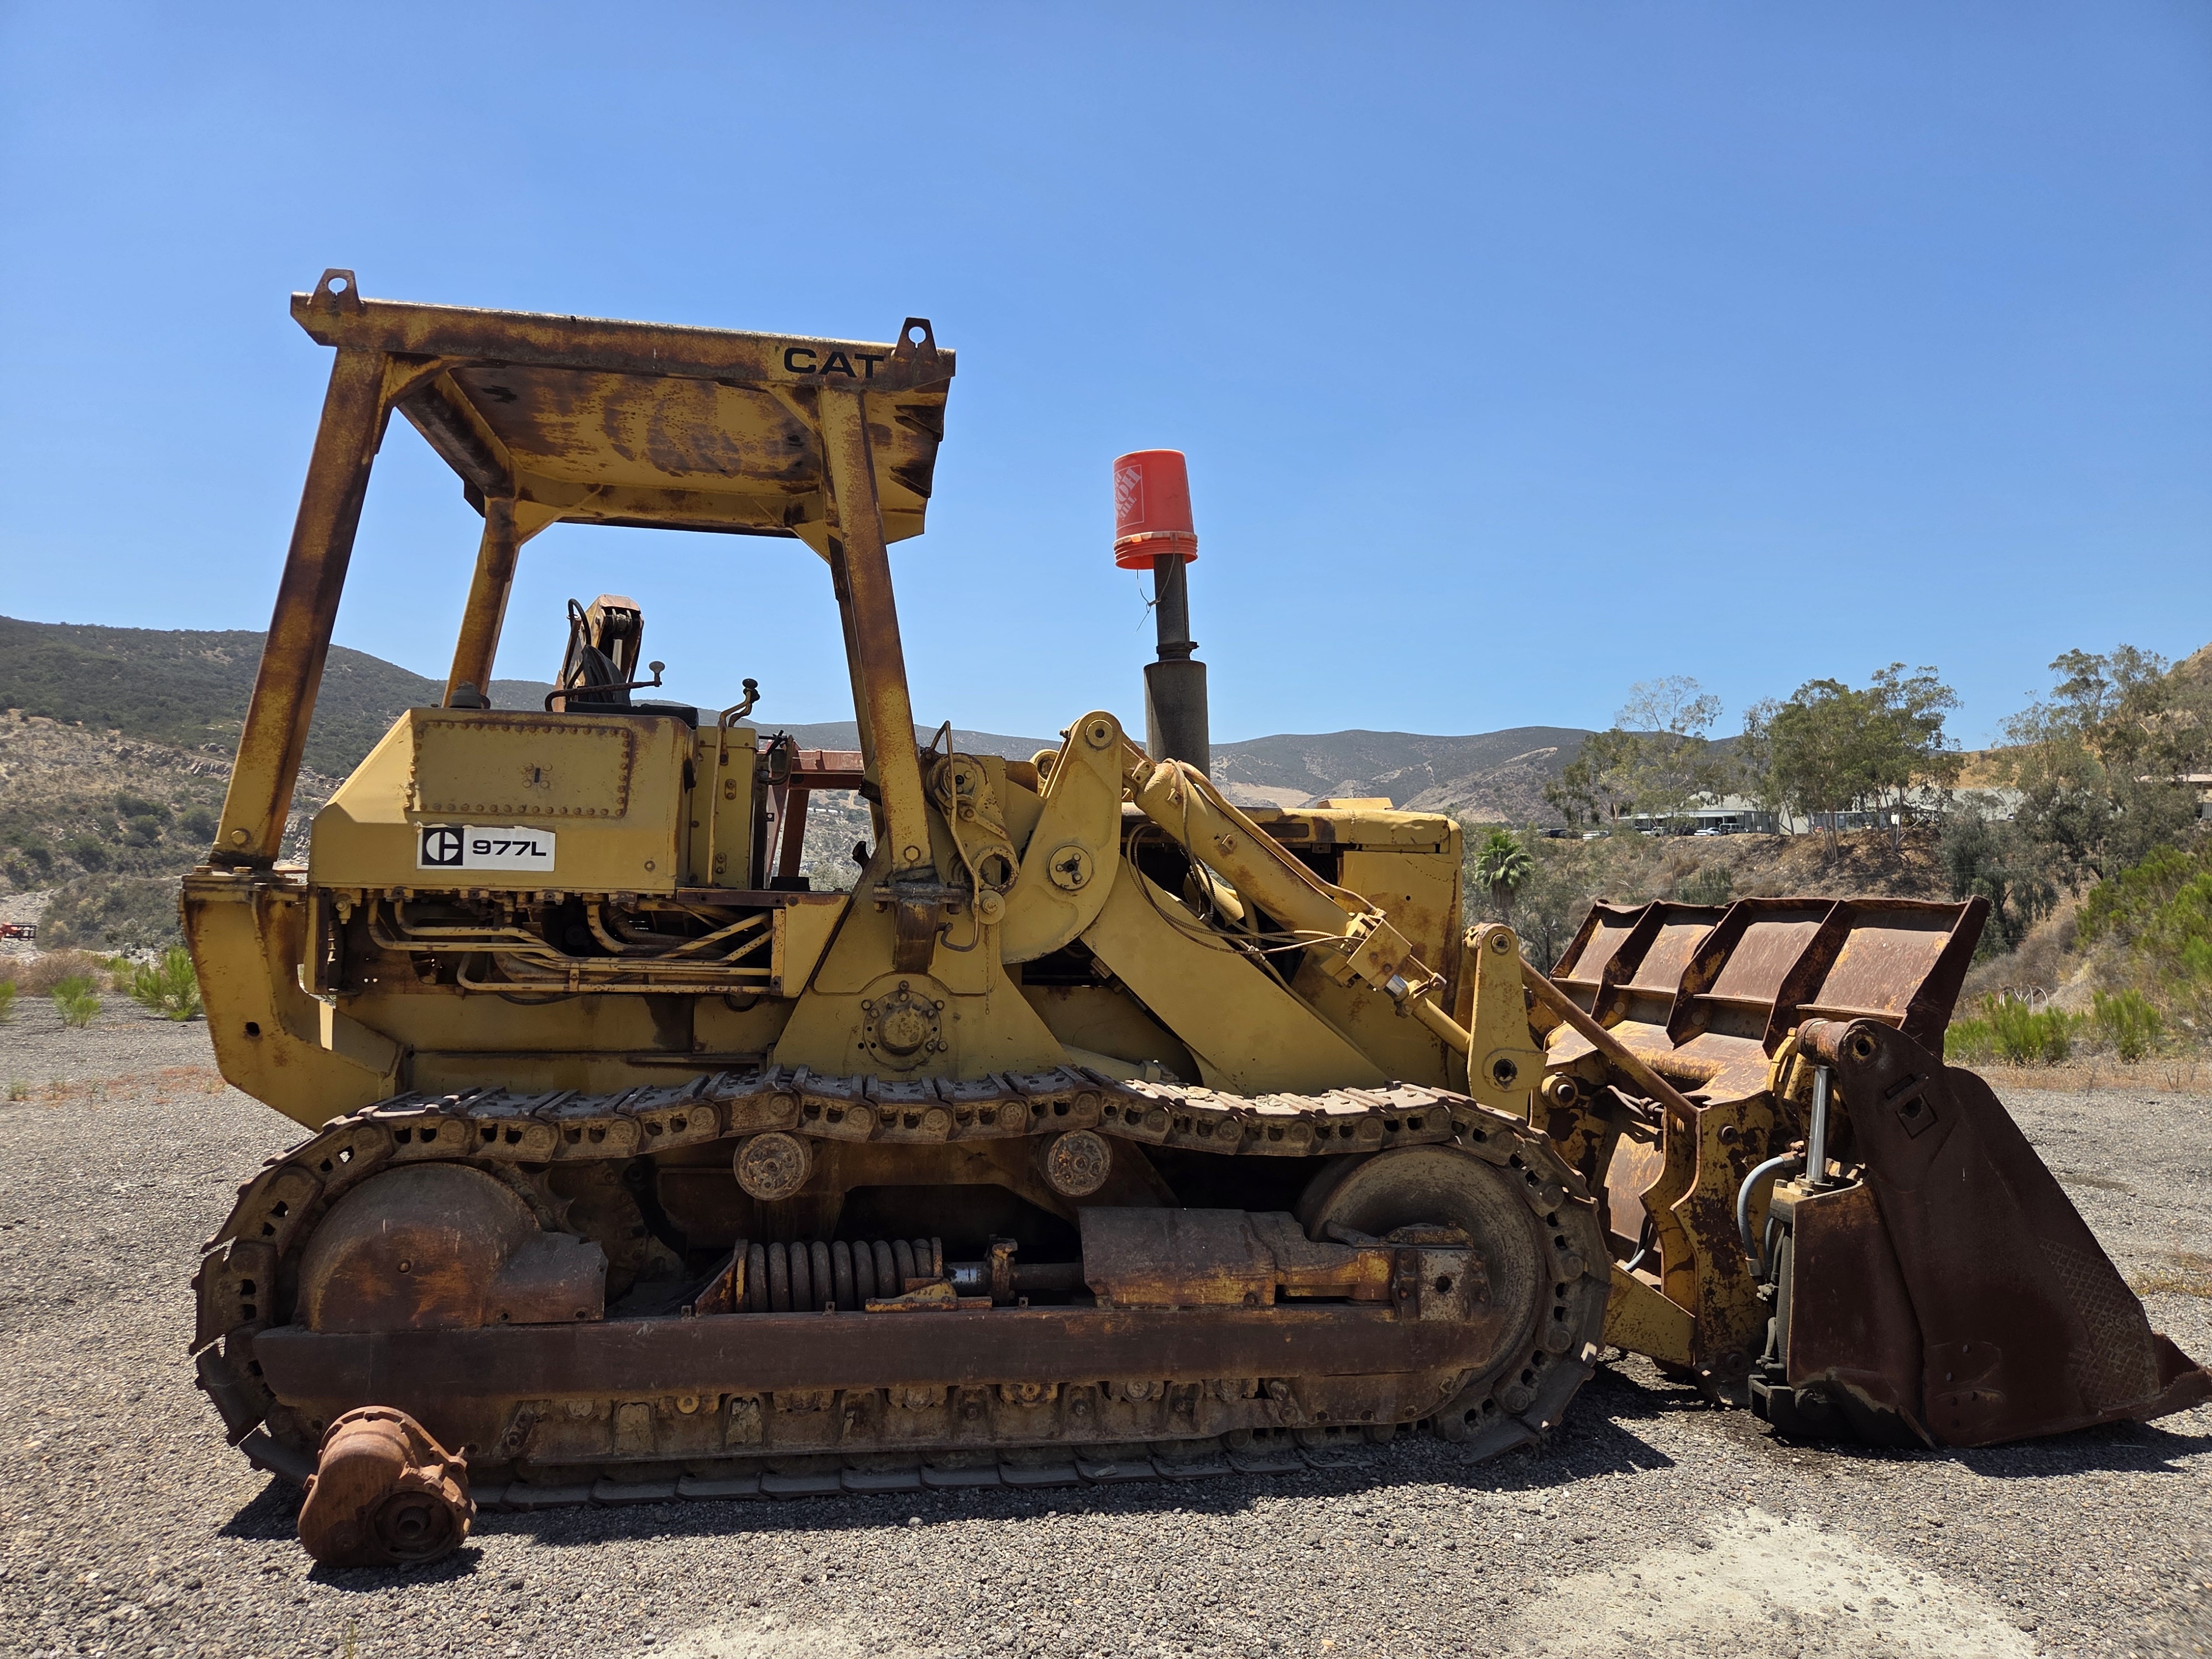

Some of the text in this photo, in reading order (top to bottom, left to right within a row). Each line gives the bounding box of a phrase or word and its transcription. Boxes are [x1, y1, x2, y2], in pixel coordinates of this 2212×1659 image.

[784, 347, 884, 379] CAT
[1114, 467, 1141, 520] HOM
[1119, 496, 1138, 521] THE
[472, 839, 546, 857] 977L
